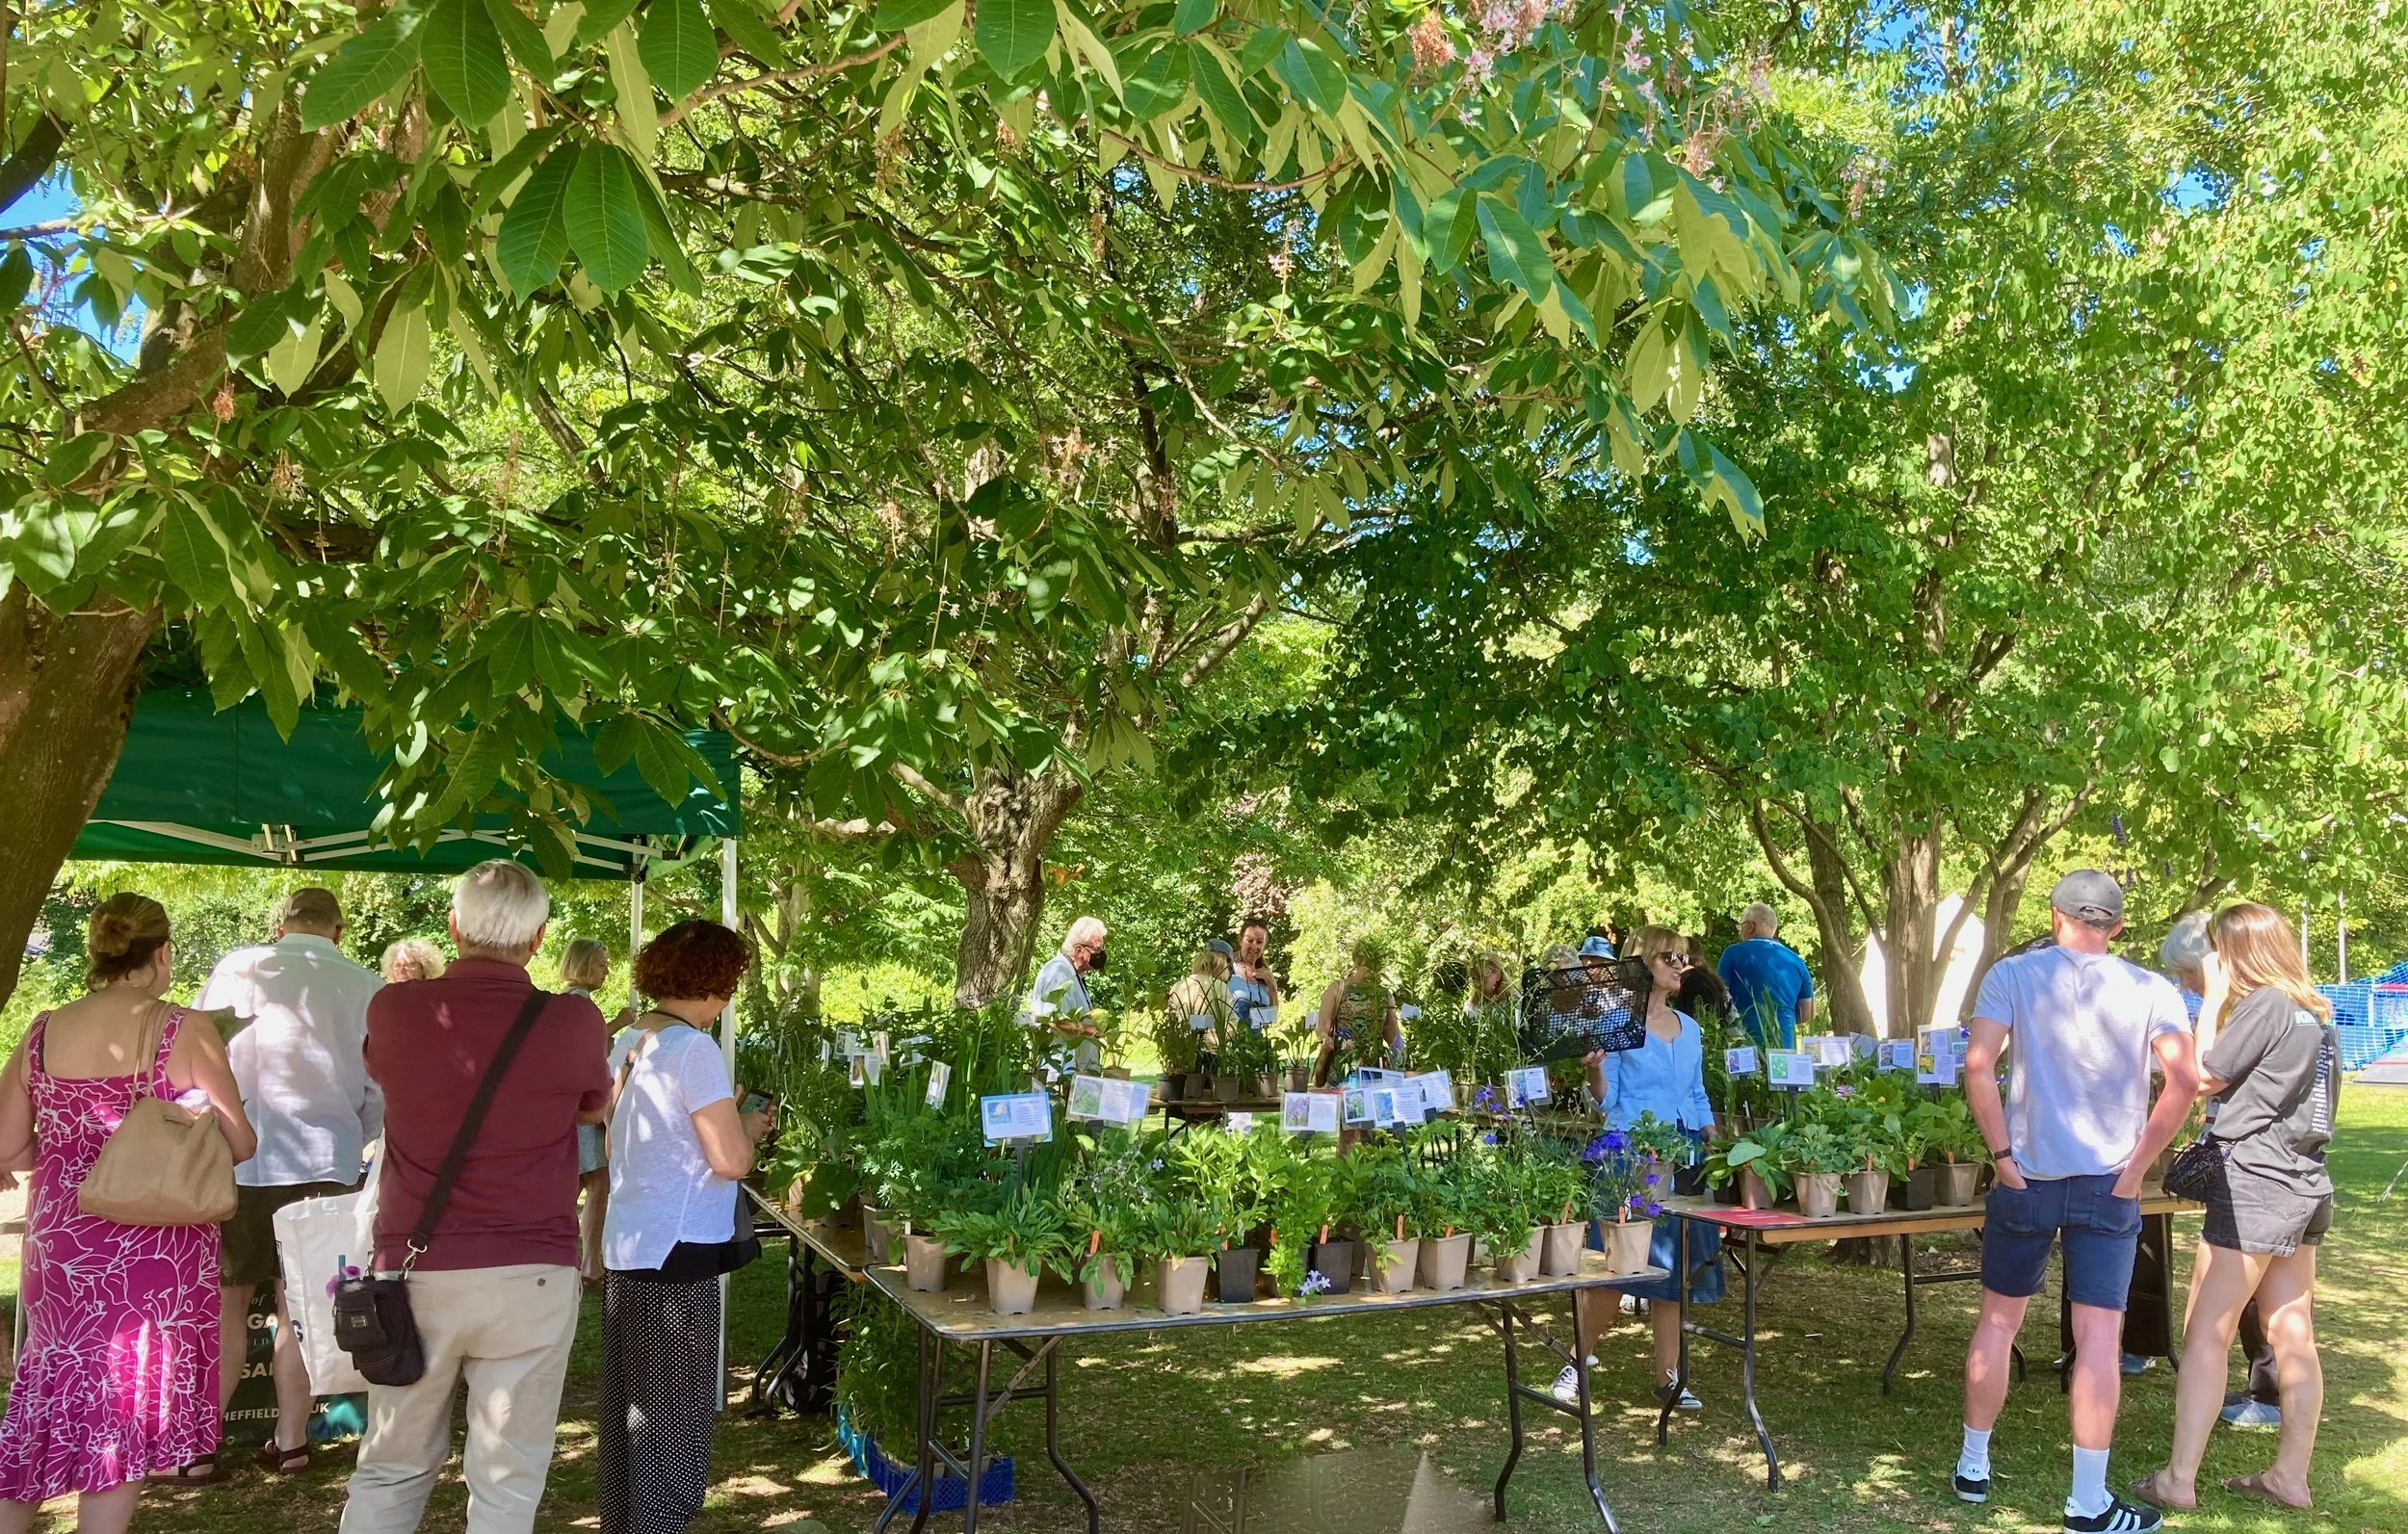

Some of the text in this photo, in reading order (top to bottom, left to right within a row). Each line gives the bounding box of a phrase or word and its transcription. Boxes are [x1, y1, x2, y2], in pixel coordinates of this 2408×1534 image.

[251, 1293, 266, 1307] of
[247, 1313, 278, 1330] GA
[291, 1319, 303, 1343] G
[222, 1408, 279, 1422] HEFFIELD
